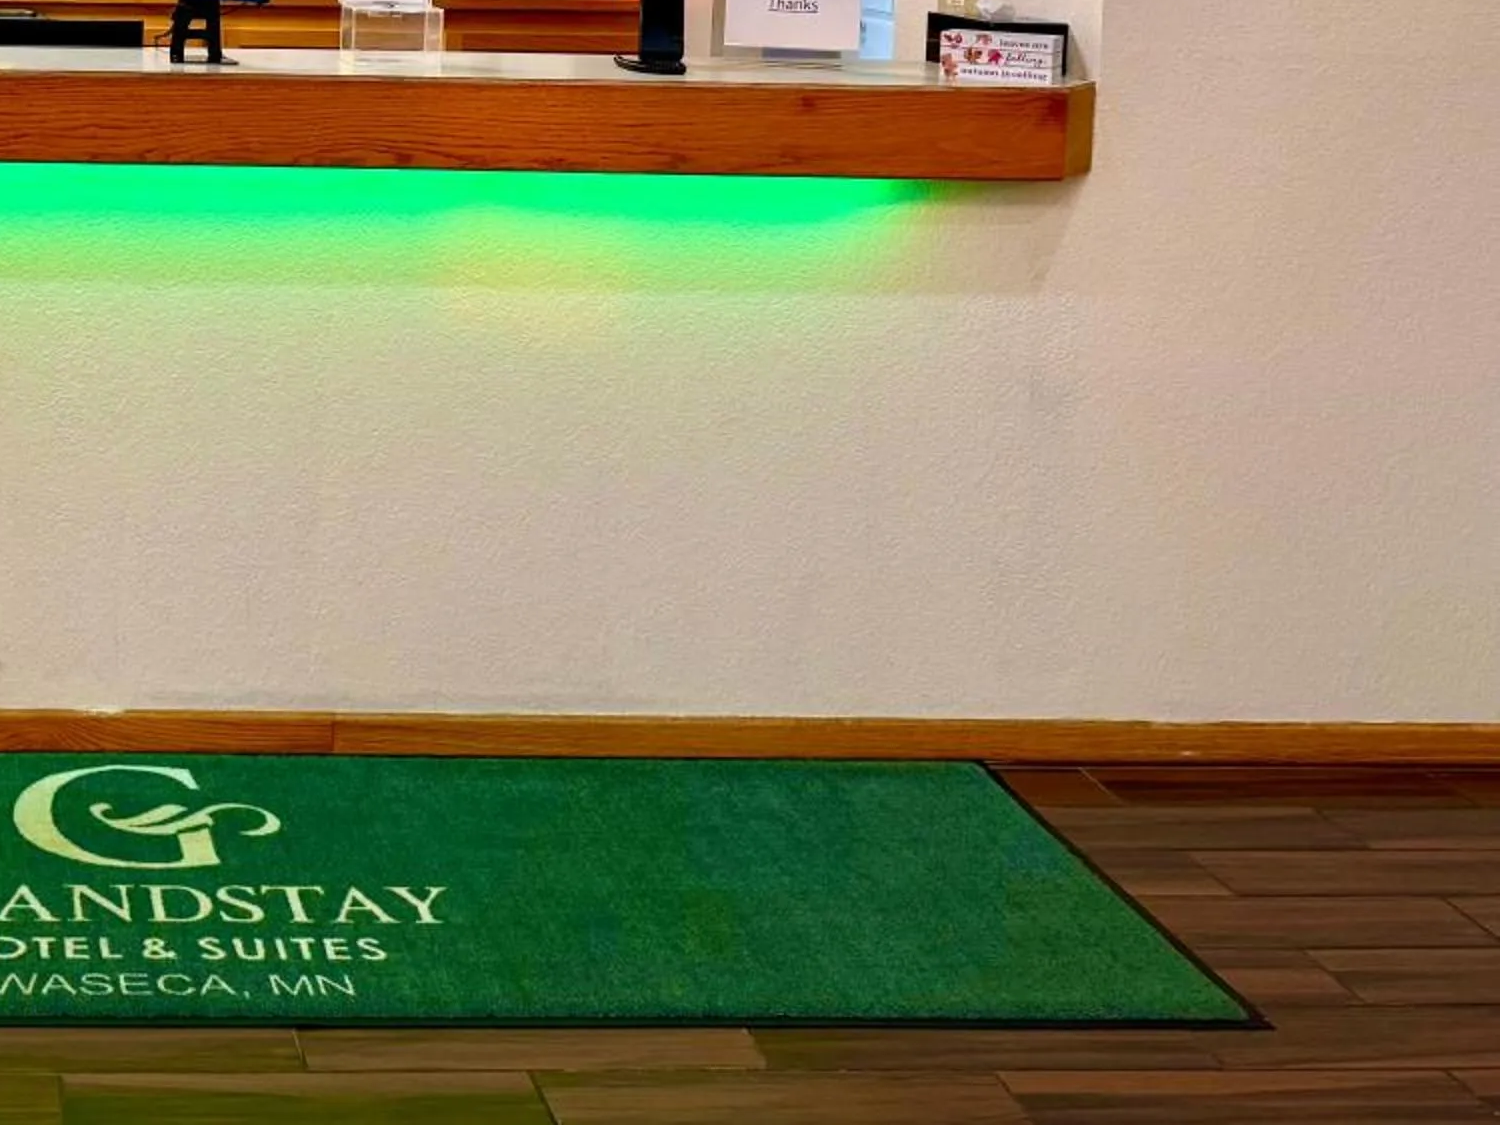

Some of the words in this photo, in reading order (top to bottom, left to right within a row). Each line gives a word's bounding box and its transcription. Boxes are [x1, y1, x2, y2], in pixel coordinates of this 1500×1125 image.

[143, 937, 176, 960] &
[199, 937, 388, 961] SUITES
[269, 975, 356, 997] MN
